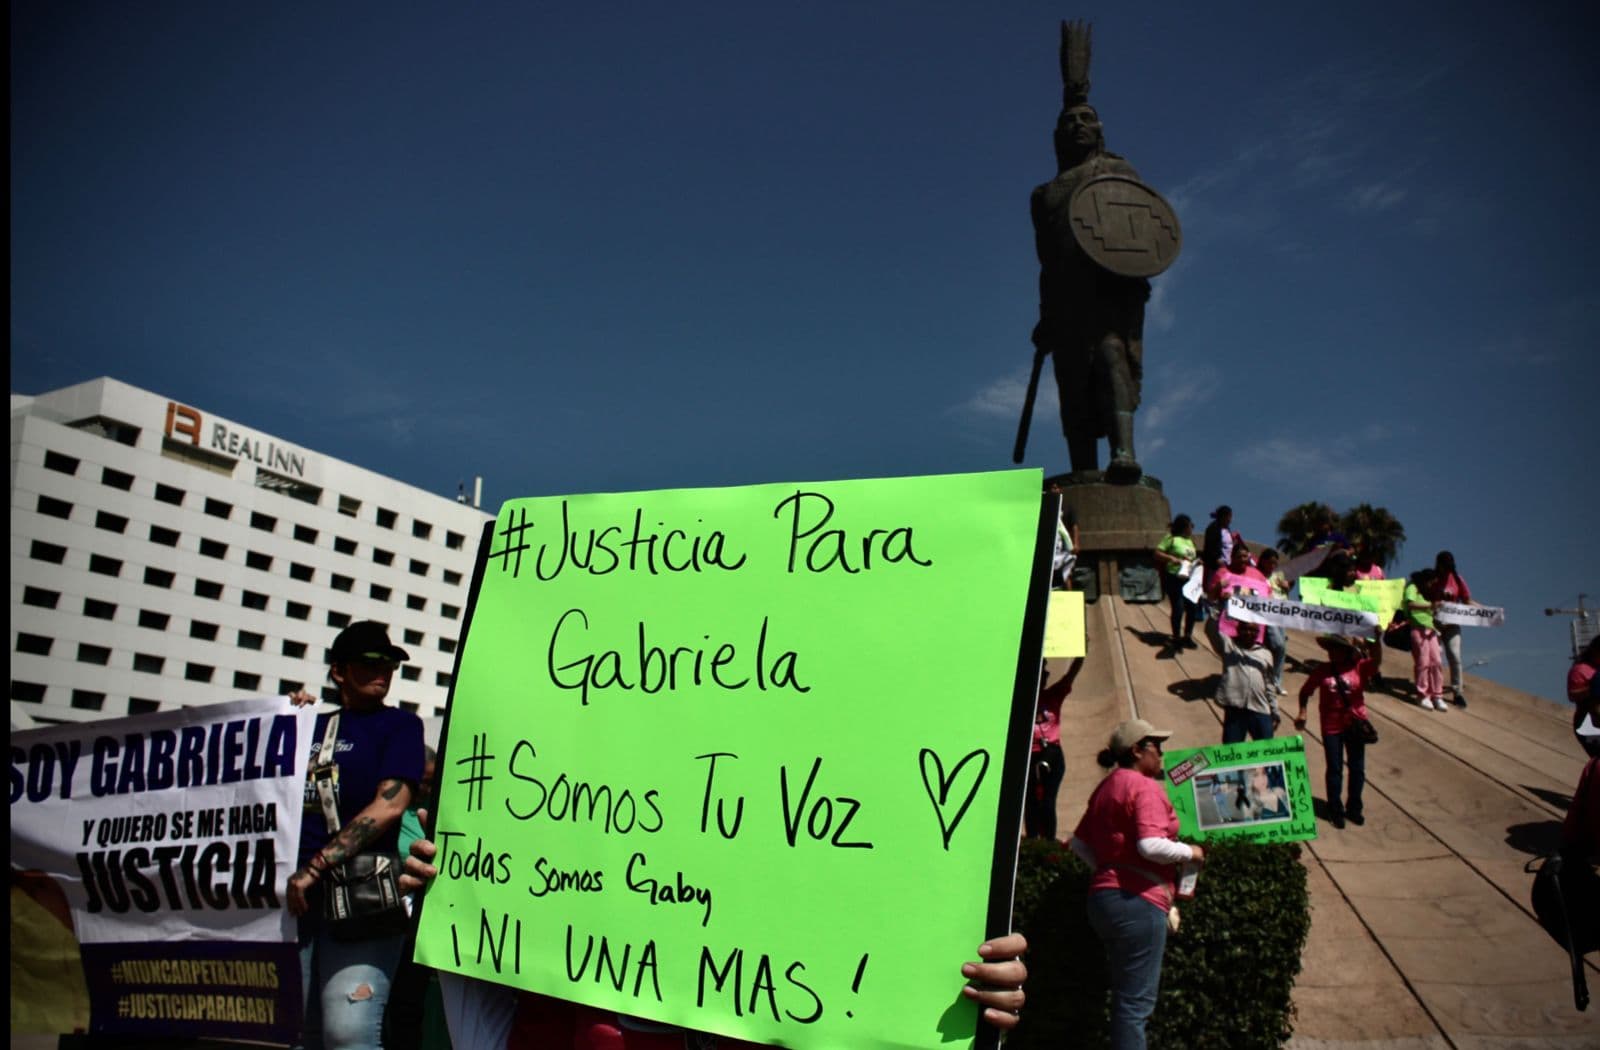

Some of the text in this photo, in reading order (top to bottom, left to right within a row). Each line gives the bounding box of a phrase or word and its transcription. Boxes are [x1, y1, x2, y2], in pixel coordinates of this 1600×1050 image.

[488, 490, 932, 582] #Justicia Para
[1231, 598, 1364, 625] #JusticiaParaGABY
[548, 609, 811, 705] Gabriela
[10, 714, 298, 804] SOY GABRIELA
[456, 733, 873, 849] #Somos Tu Voz
[1295, 765, 1309, 813] MAS
[82, 803, 278, 846] Y QUIERO SE ME HAGA
[76, 838, 281, 914] JUSTICIA
[436, 830, 512, 885] Todas
[626, 853, 712, 928] Gaby
[566, 925, 662, 999] UNA
[118, 993, 275, 1025] #JUSTICIAPARAGABY
